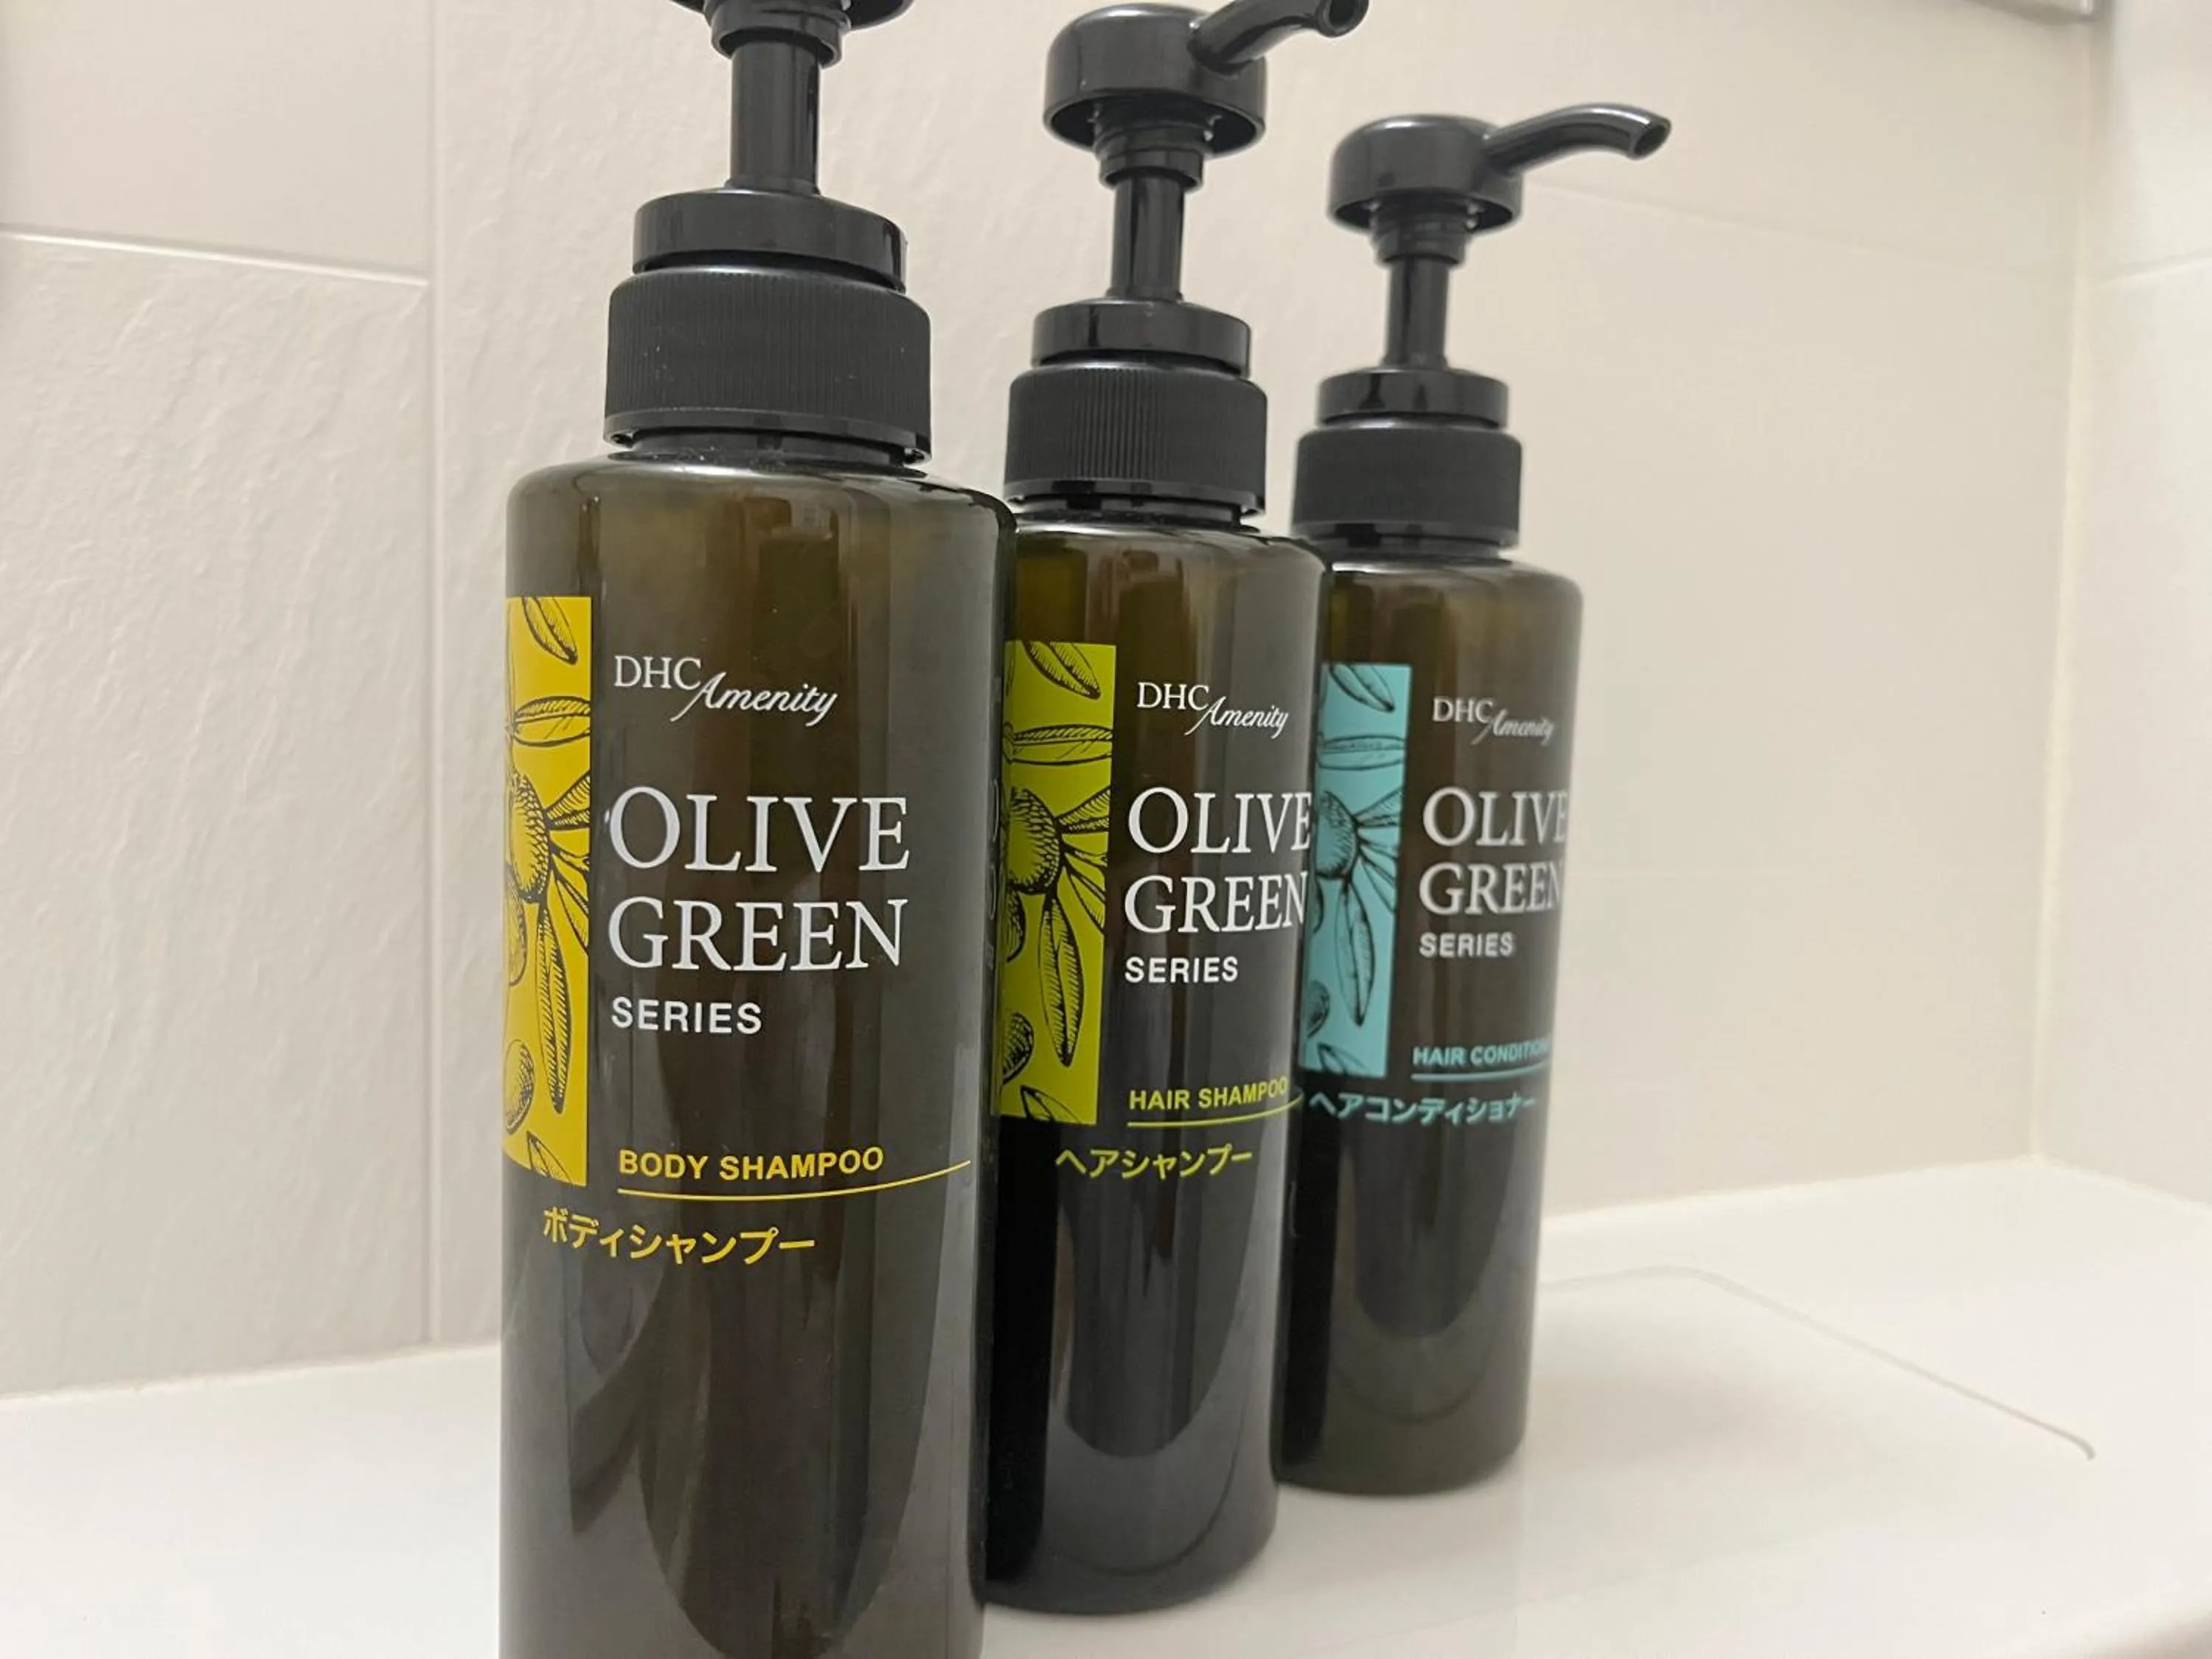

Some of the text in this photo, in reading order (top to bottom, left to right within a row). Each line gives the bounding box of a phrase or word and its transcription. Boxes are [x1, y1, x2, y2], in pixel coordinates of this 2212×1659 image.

[614, 655, 838, 727] DHC Amenity
[1137, 682, 1290, 739] DHC Amenity
[1433, 697, 1554, 746] DHC Amenity
[610, 786, 910, 872] OLIVE
[1127, 787, 1312, 854] OLIVE
[1422, 786, 1568, 846] OLIVE
[1124, 872, 1309, 933] GREEN
[608, 897, 908, 971] GREEN
[1419, 932, 1514, 957] SERIES
[1124, 956, 1239, 984] SERIES
[611, 997, 762, 1034] SERIES
[1412, 1046, 1465, 1066] HAIR
[1129, 1076, 1289, 1110] HAIR SHAMPOO
[1309, 1091, 1537, 1127] ヘアコンディショナー
[619, 1147, 885, 1180] BODY SHAMPOO
[1054, 1143, 1252, 1180] ヘアシャンプー
[543, 1206, 815, 1265] ボディシャンプー
